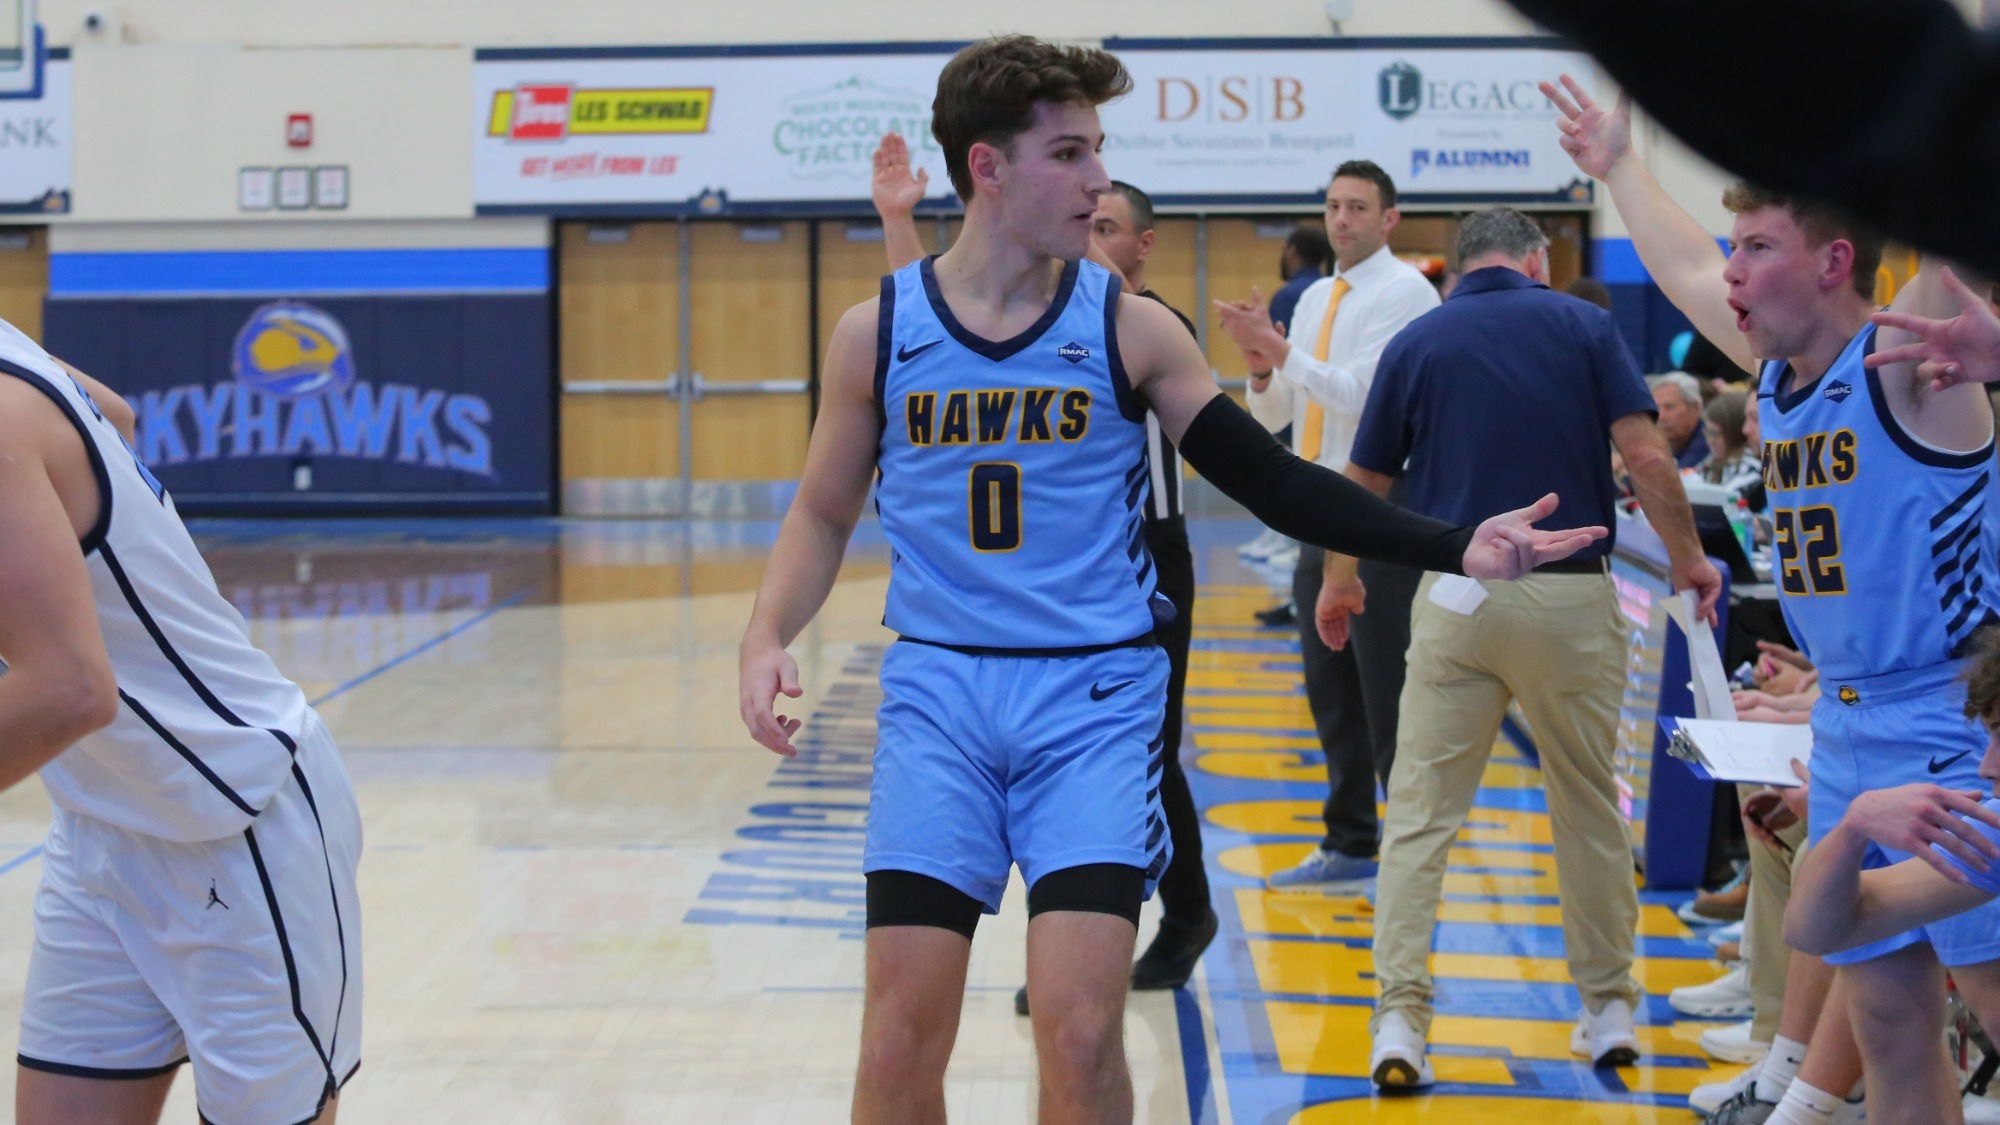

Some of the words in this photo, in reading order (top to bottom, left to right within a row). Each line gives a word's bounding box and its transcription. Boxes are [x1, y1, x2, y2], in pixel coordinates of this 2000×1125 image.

[576, 101, 607, 121] LES
[615, 100, 703, 121] SCHWAB
[0, 117, 60, 149] NK
[1435, 150, 1531, 167] ALUMNI
[1058, 346, 1090, 358] RMAC
[1824, 385, 1852, 399] RMAC
[906, 387, 1093, 446] HAWKS
[968, 460, 1023, 554] 0
[1774, 503, 1849, 596] 22
